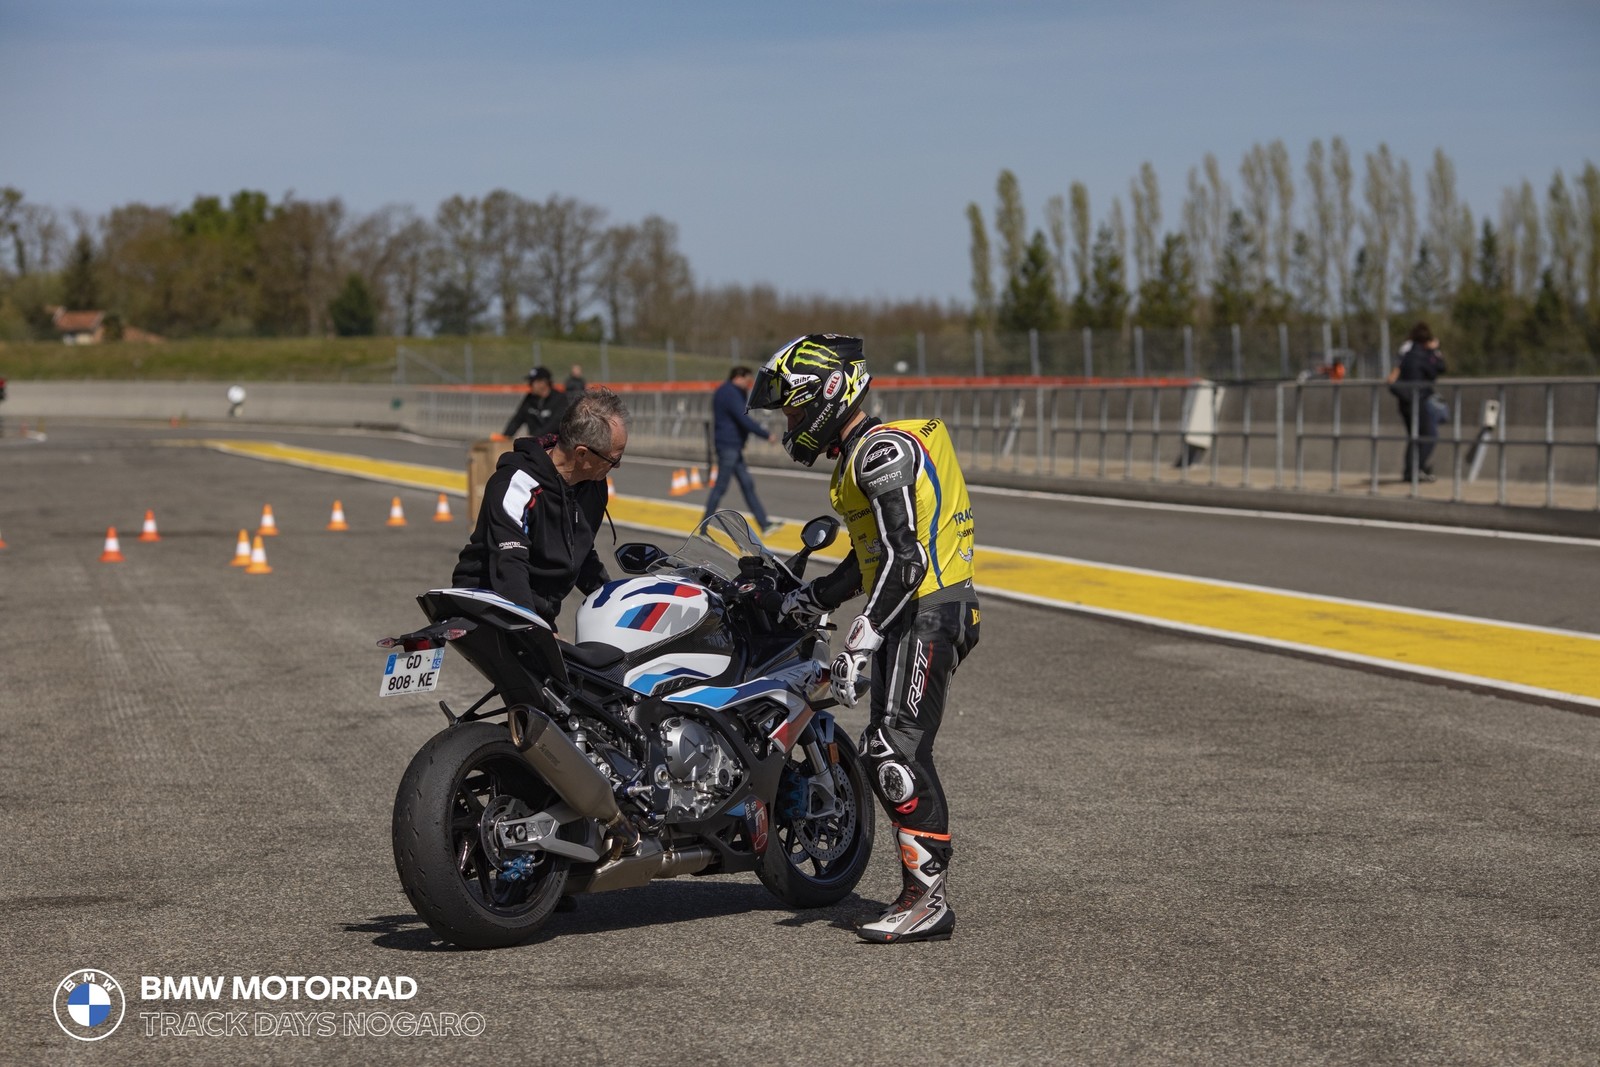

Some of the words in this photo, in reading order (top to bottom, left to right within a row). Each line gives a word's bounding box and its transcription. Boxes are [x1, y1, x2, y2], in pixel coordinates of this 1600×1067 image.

[826, 375, 841, 396] BELL
[808, 402, 834, 434] MONSTER
[953, 507, 974, 526] TRAC
[406, 654, 422, 669] GD
[906, 638, 929, 718] RST
